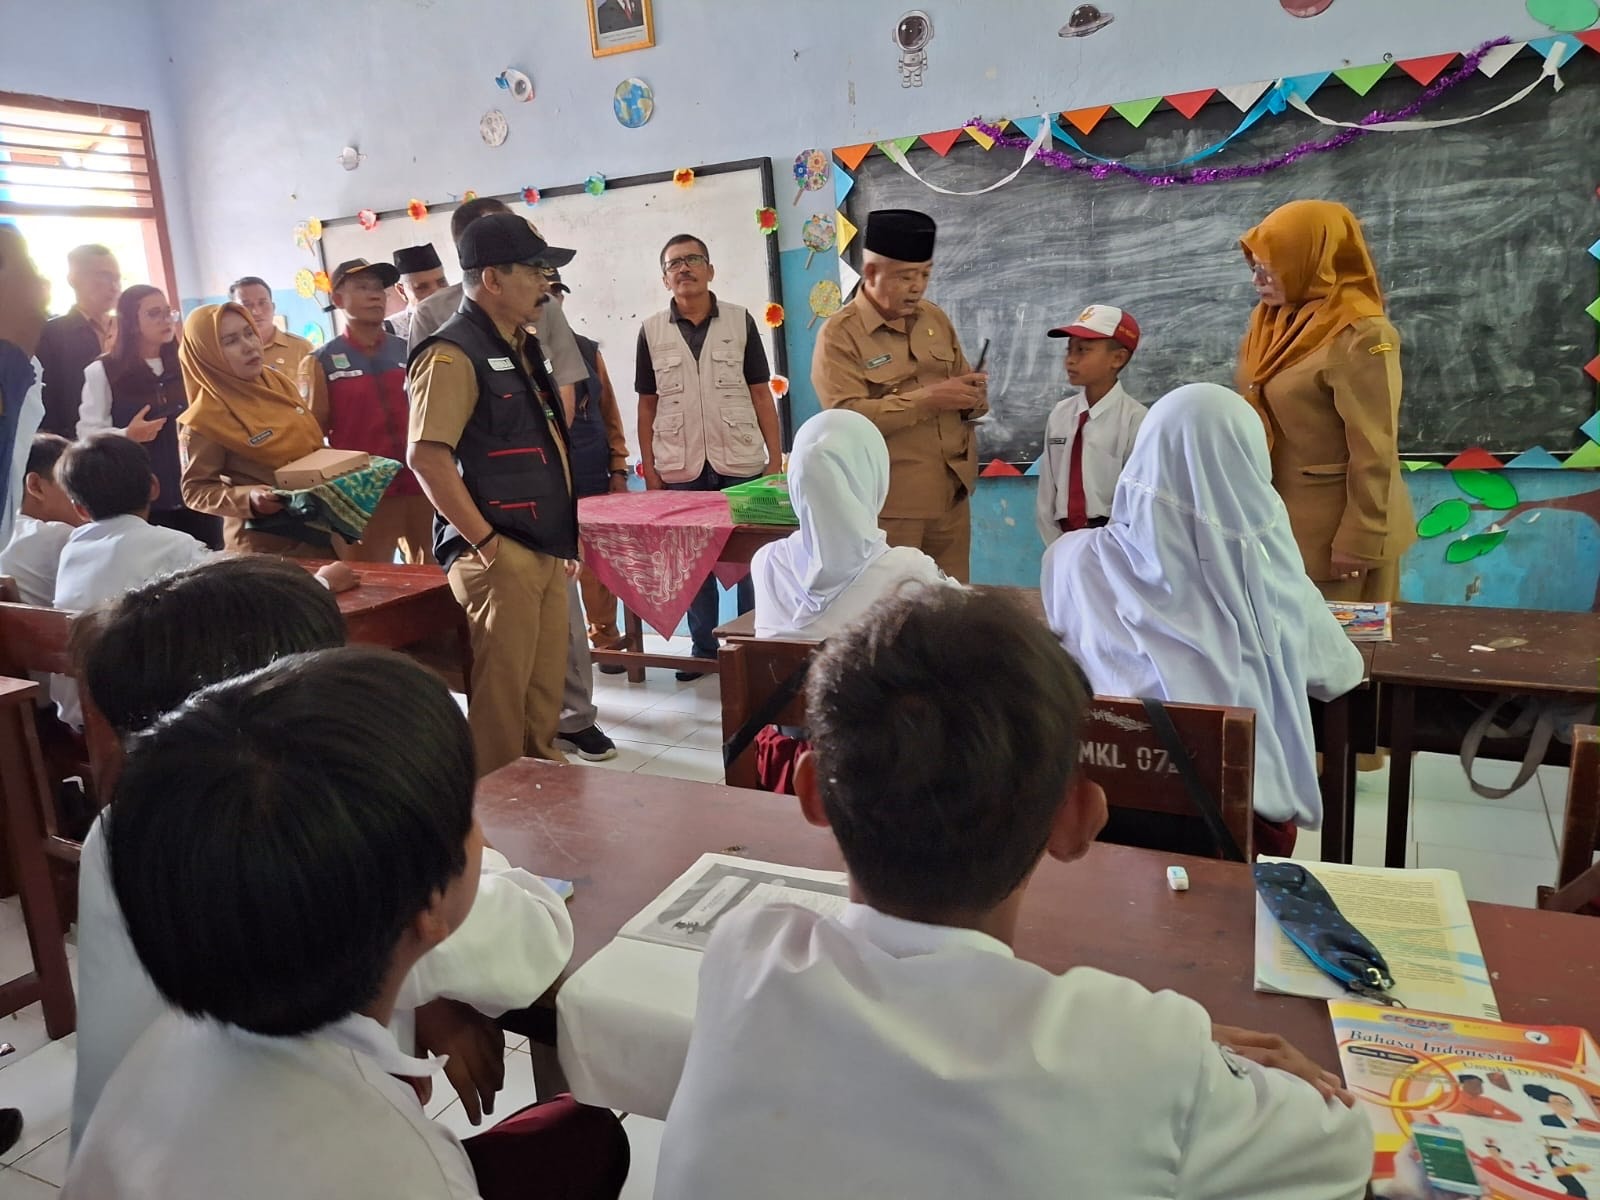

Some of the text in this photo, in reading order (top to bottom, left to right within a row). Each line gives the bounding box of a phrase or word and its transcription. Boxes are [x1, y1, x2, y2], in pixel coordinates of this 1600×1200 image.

[1078, 741, 1126, 768] MKL
[1350, 1030, 1414, 1049] Bahasa
[1424, 1042, 1513, 1062] Indonesia
